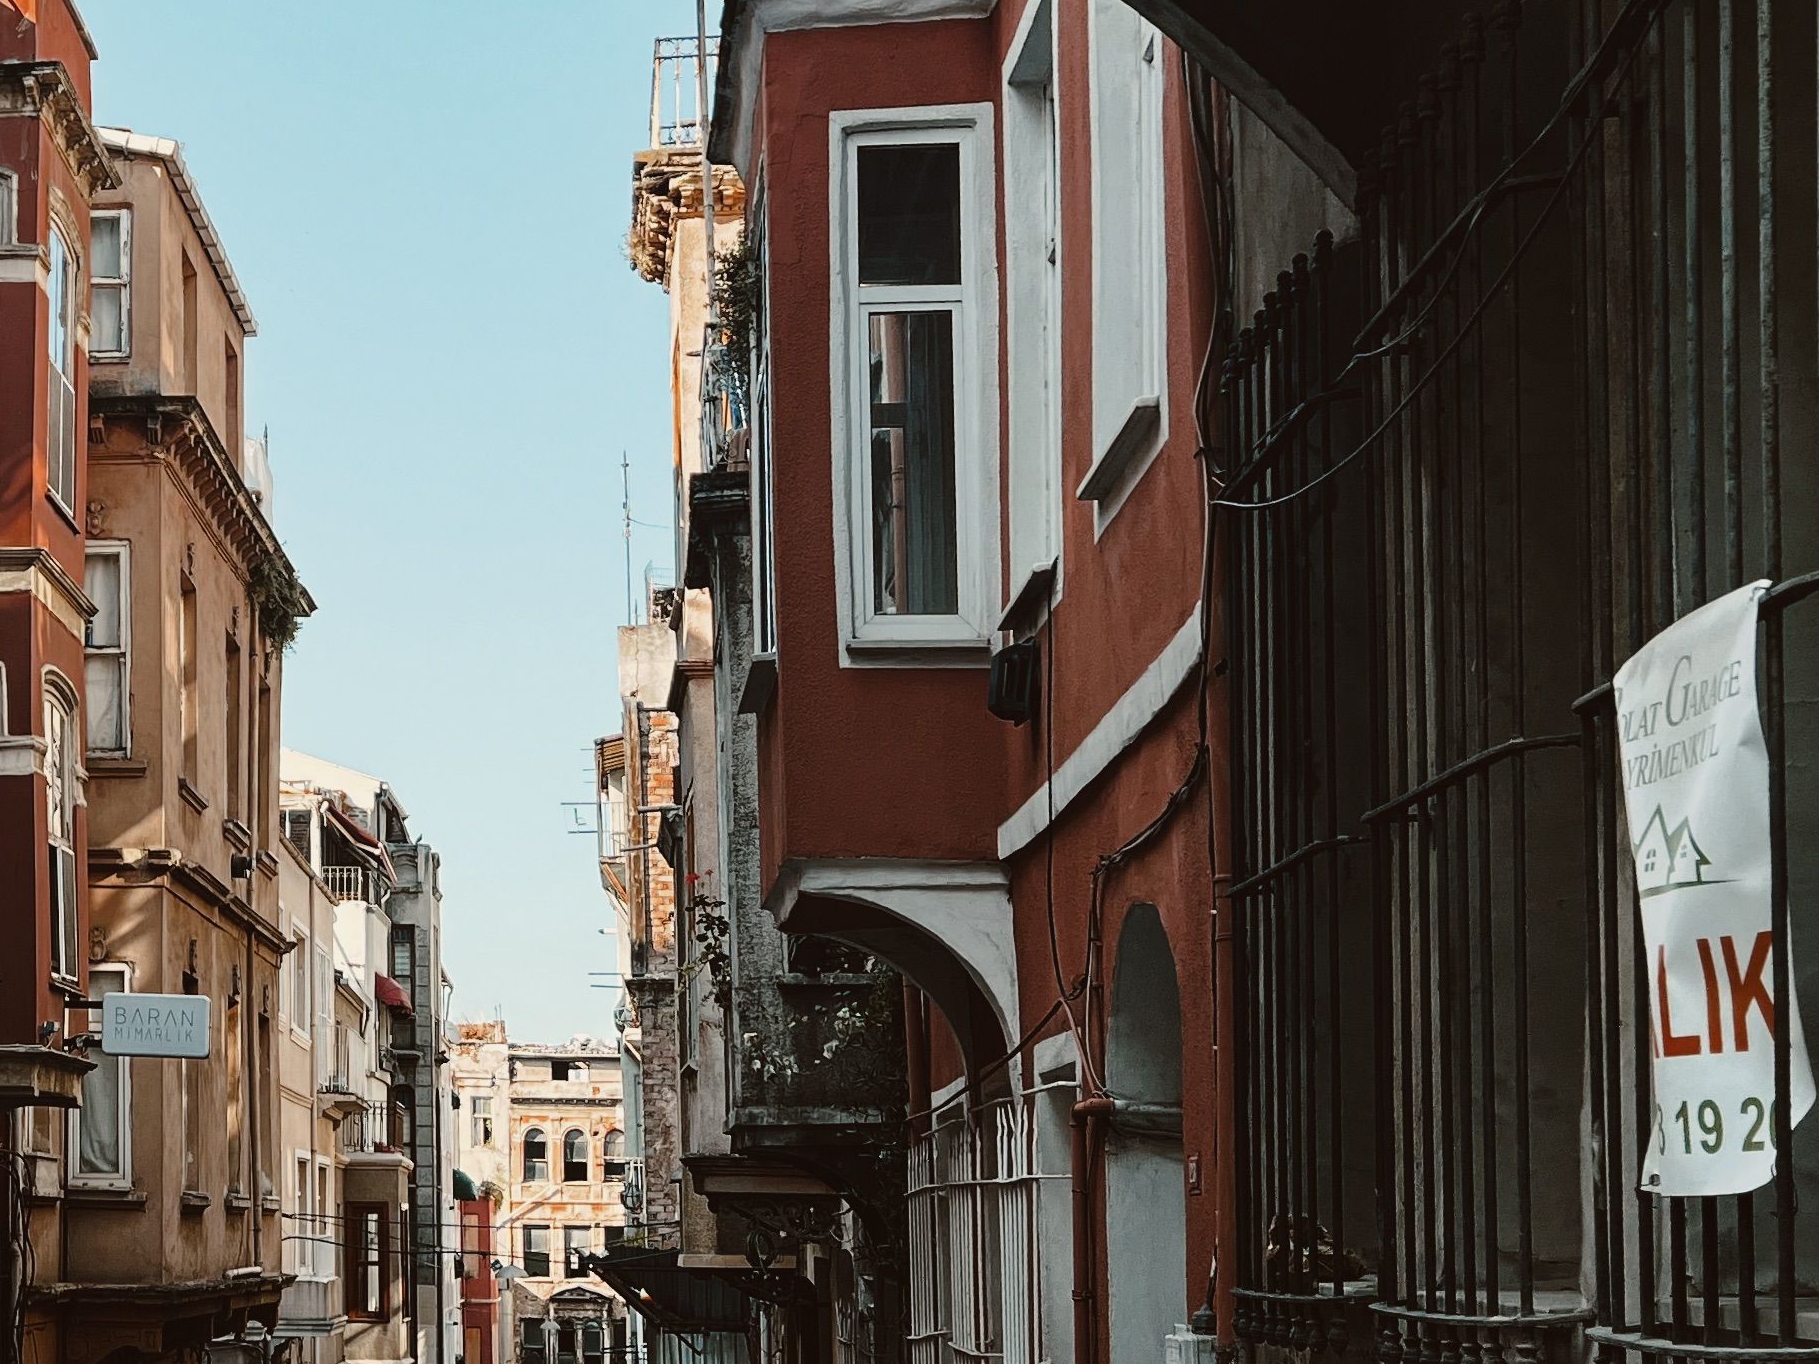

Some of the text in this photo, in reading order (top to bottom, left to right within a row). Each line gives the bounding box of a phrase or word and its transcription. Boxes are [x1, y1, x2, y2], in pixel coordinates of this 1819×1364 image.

[1666, 655, 1741, 726] GARAGE
[1627, 724, 1719, 790] YRİMENKUL
[115, 1007, 194, 1027] BARAN
[1653, 931, 1775, 1058] LIK
[1676, 1099, 1723, 1154] 19
